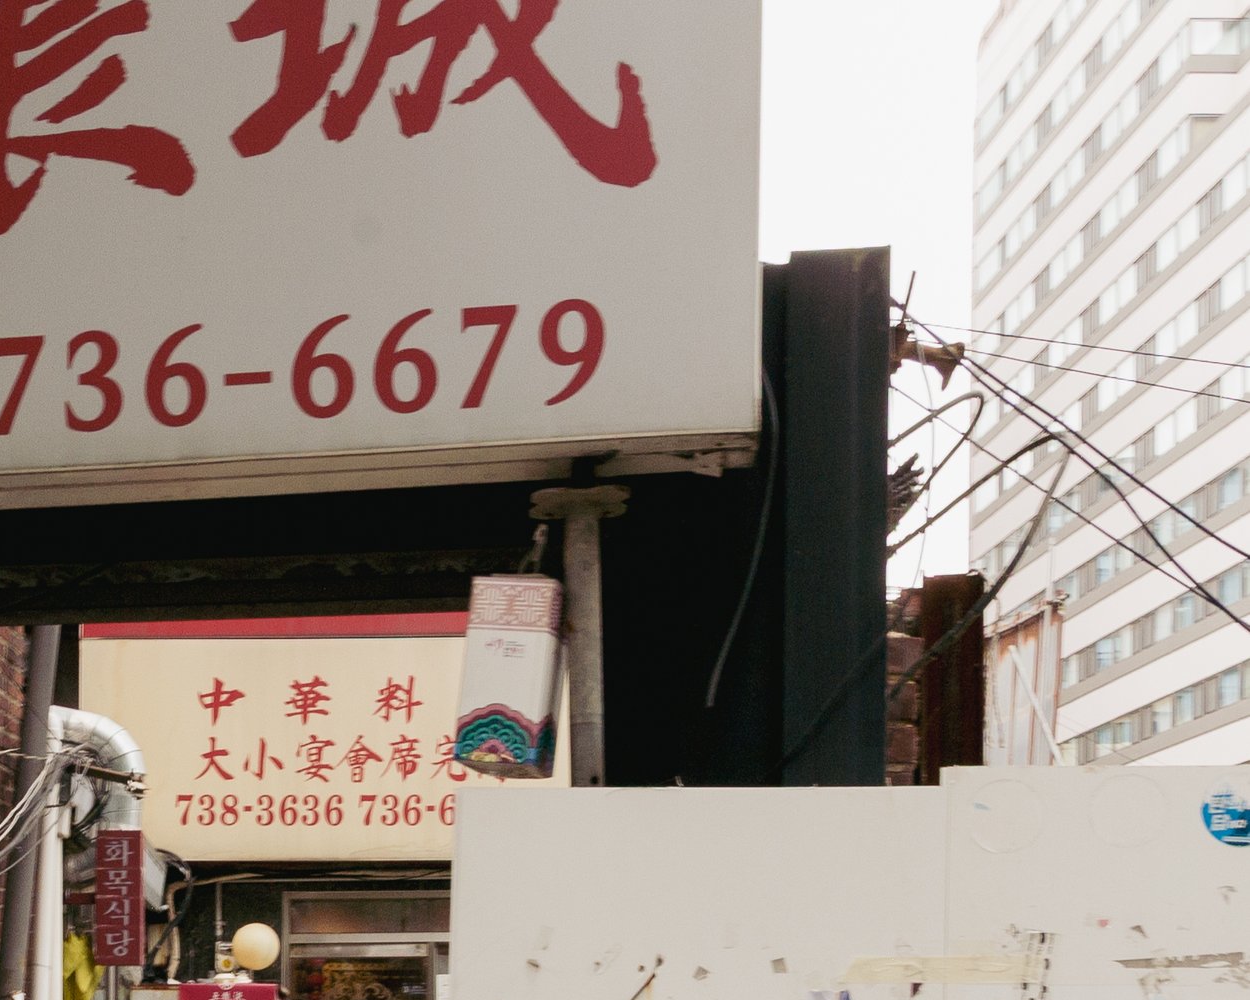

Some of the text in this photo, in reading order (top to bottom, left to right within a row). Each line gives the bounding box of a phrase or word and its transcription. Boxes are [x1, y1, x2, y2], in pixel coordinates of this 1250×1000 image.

[195, 734, 507, 784] 大小宴會席完
[175, 794, 344, 827] 738-3636
[102, 840, 134, 957] 화목식당
